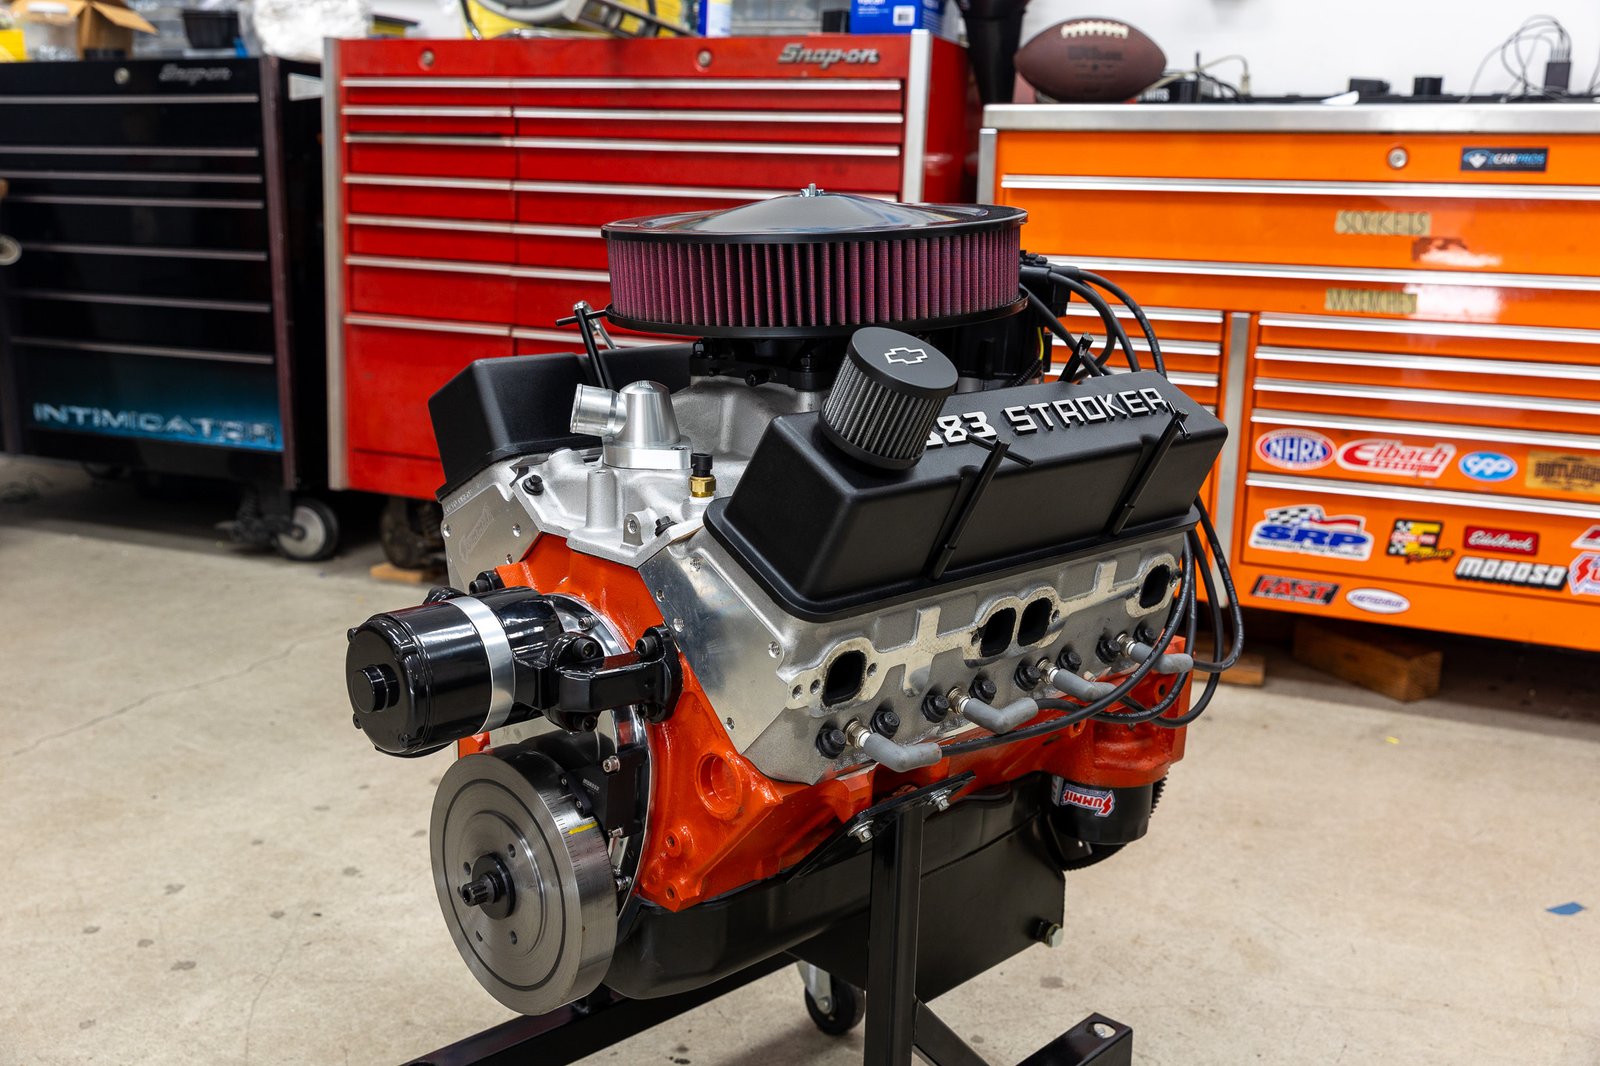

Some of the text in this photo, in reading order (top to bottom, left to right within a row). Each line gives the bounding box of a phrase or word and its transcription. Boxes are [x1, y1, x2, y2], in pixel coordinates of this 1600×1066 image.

[777, 43, 880, 69] Snap-on
[1339, 210, 1428, 234] SOCKETS
[1002, 387, 1169, 434] STROKER
[1268, 436, 1326, 463] NHRA
[1257, 525, 1368, 547] SRP
[1468, 530, 1533, 551] Edelbrock
[1456, 556, 1569, 586] MOROSO
[1258, 578, 1331, 600] FAST
[1064, 790, 1113, 815] SUMMIT
